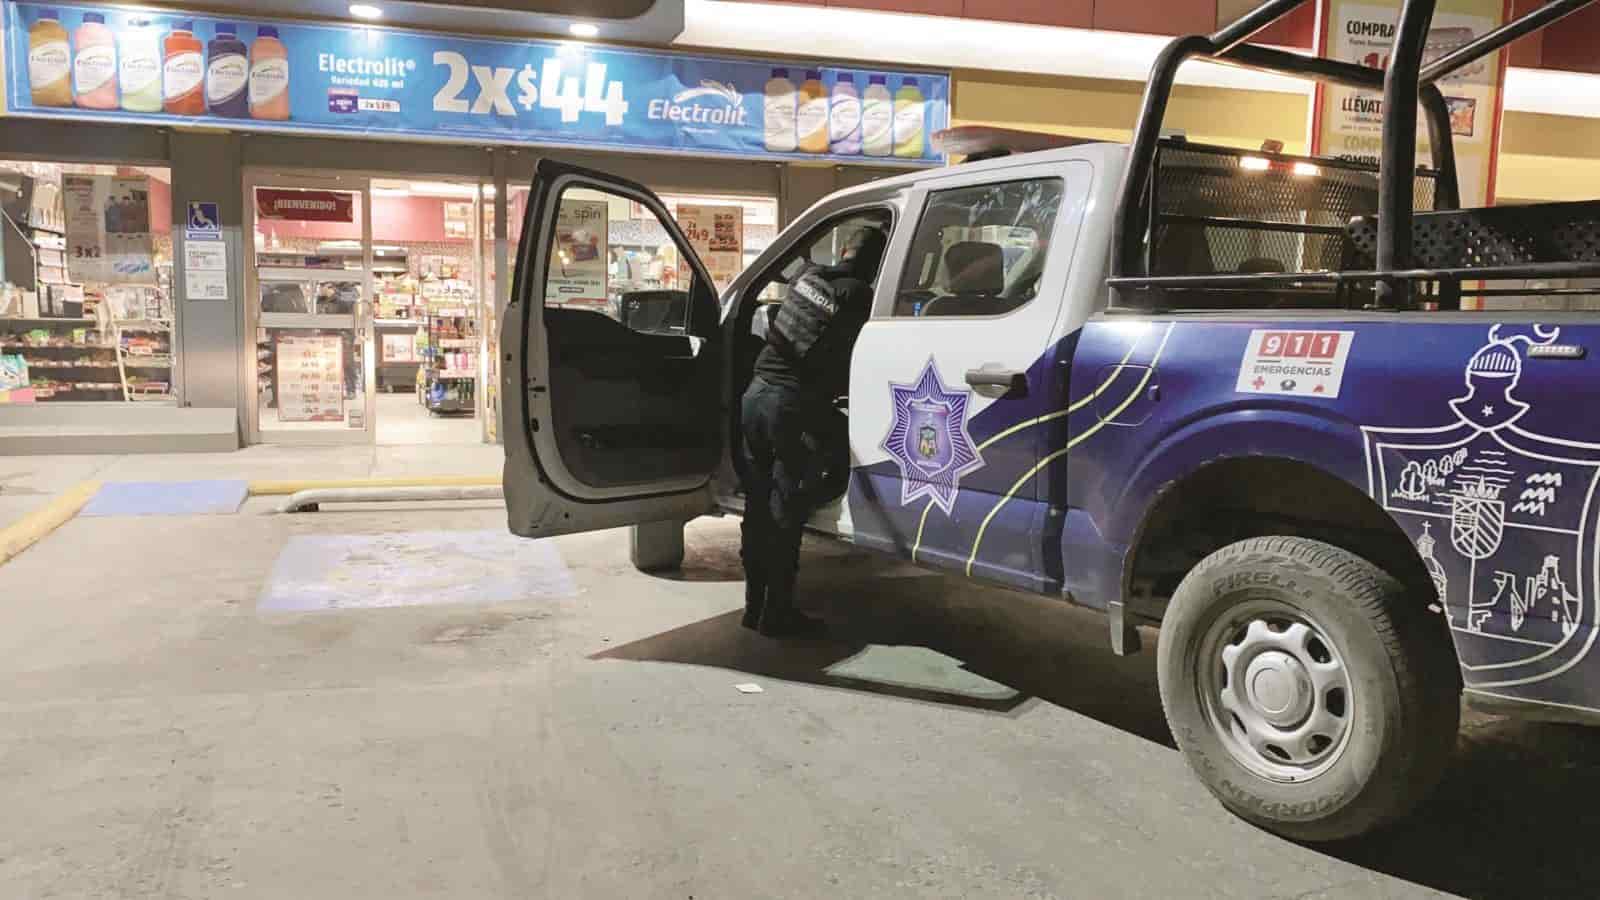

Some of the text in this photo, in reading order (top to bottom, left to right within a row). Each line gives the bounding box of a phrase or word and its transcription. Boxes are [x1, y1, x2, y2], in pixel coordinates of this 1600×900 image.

[647, 98, 749, 126] Electrolit
[1342, 96, 1384, 113] LLÉVAT
[1253, 365, 1332, 377] EMERGENCIAS
